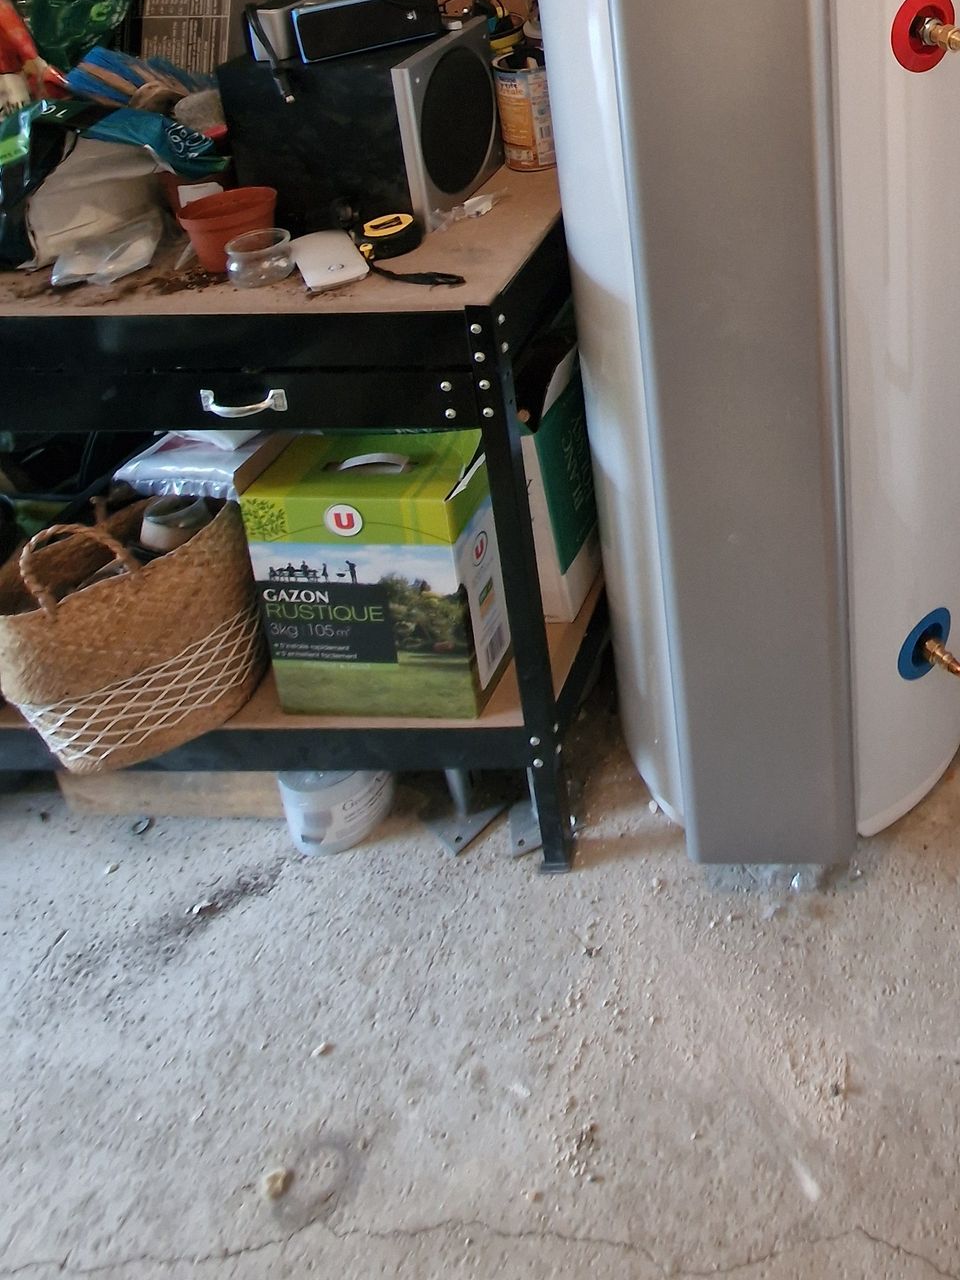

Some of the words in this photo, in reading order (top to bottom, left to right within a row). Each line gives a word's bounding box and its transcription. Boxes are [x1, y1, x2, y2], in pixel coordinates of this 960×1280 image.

[334, 513, 355, 529] U
[262, 588, 330, 604] GAZON
[265, 603, 385, 622] RUSTIQUE
[270, 622, 299, 639] 3kg
[308, 623, 335, 637] 105
